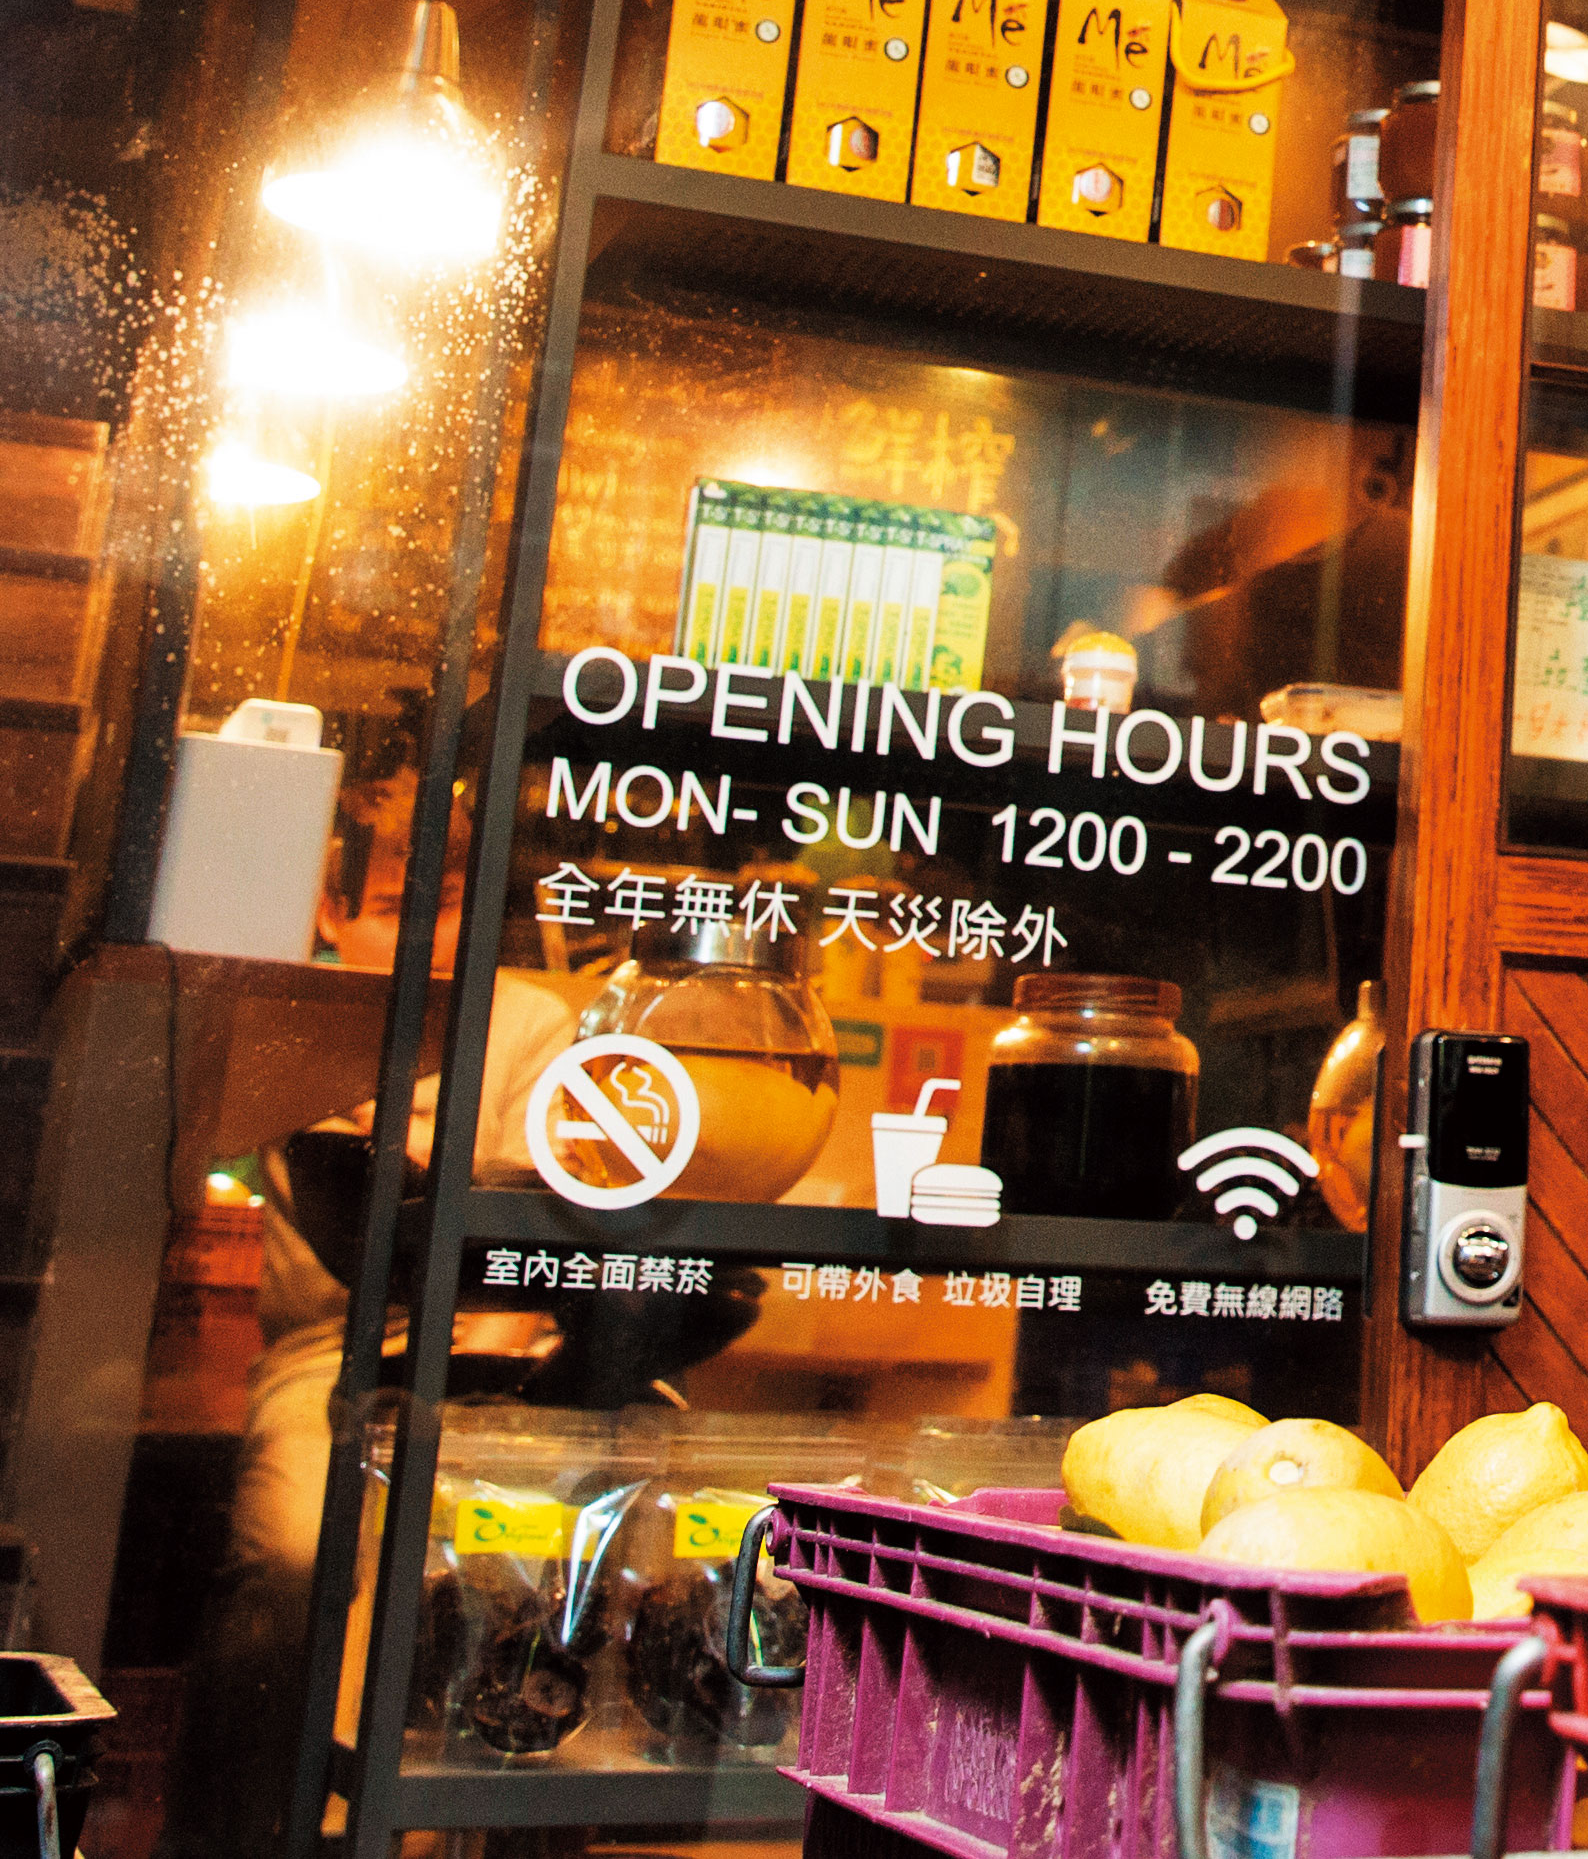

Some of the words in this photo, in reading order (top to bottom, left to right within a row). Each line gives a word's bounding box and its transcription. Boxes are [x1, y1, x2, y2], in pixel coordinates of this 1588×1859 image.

[562, 646, 1015, 770] OPENING
[1048, 694, 1370, 804] HOURS
[782, 782, 941, 856] SUN
[992, 805, 1147, 875] 1200
[1211, 826, 1367, 895] 2200
[535, 862, 799, 943] 全年無休
[819, 887, 1068, 966] 天災除外
[483, 1247, 714, 1295] 室內全面禁菸
[782, 1262, 922, 1304] 可帶外食
[943, 1272, 1082, 1311] 垃圾自理
[1144, 1280, 1343, 1321] 免費無線網路
